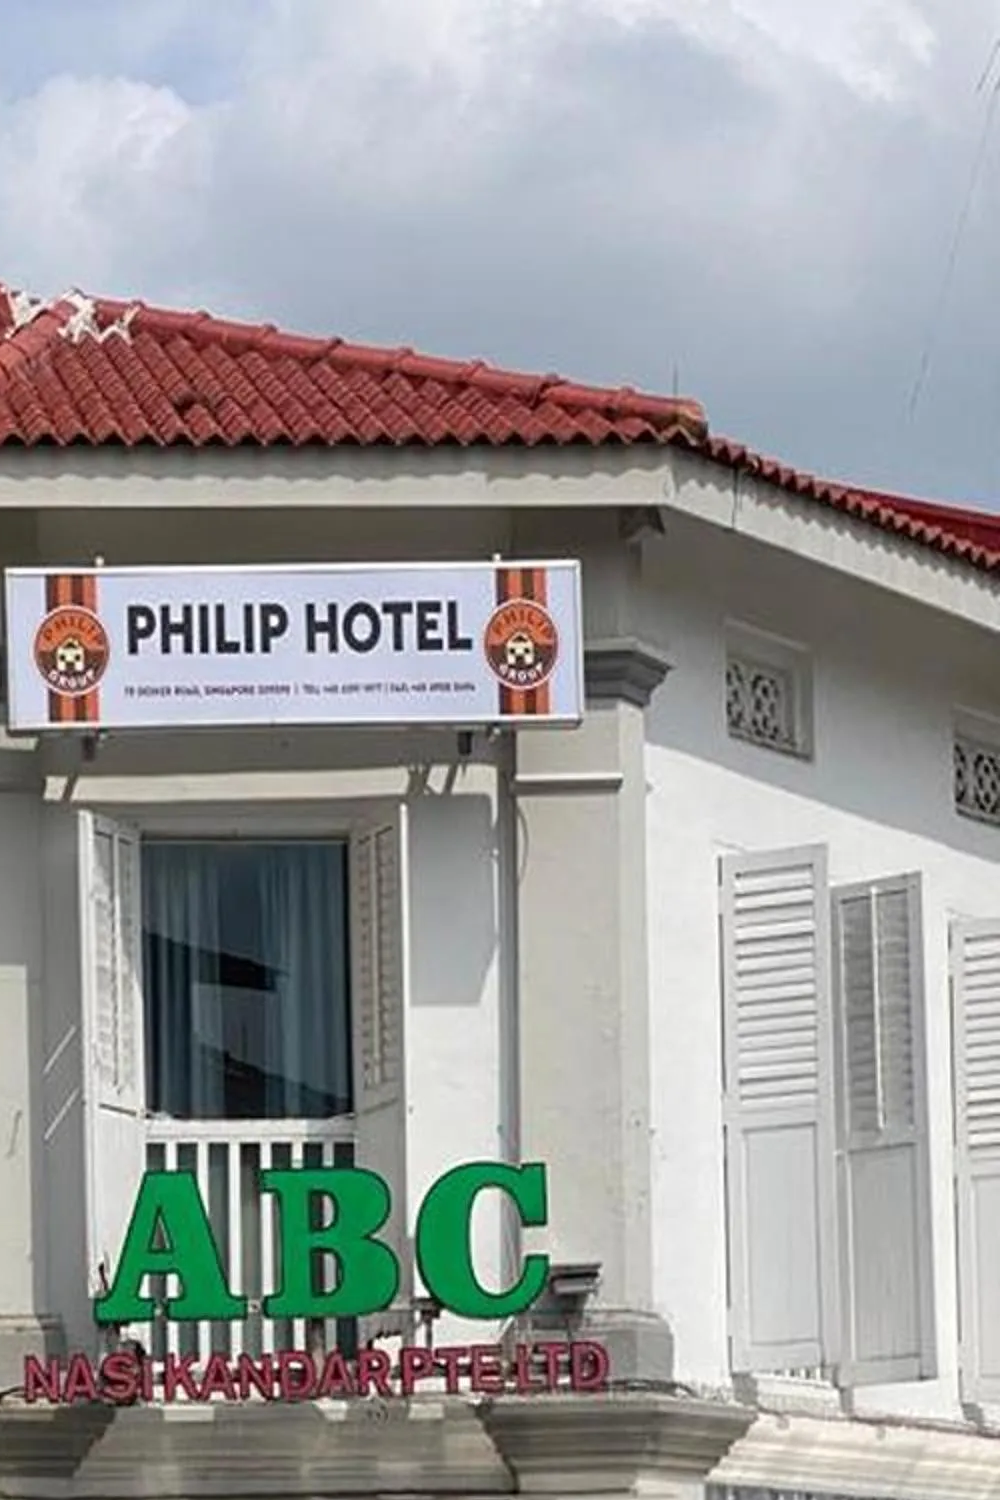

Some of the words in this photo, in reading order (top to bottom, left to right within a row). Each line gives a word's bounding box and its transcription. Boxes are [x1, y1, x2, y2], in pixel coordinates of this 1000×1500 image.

[126, 603, 287, 655] PHILIP
[305, 600, 473, 653] HOTEL
[93, 1161, 550, 1326] ABC
[23, 1349, 153, 1405] NASI
[162, 1346, 394, 1402] KANDAR
[399, 1343, 504, 1395] PTE
[514, 1340, 610, 1392] LTD
